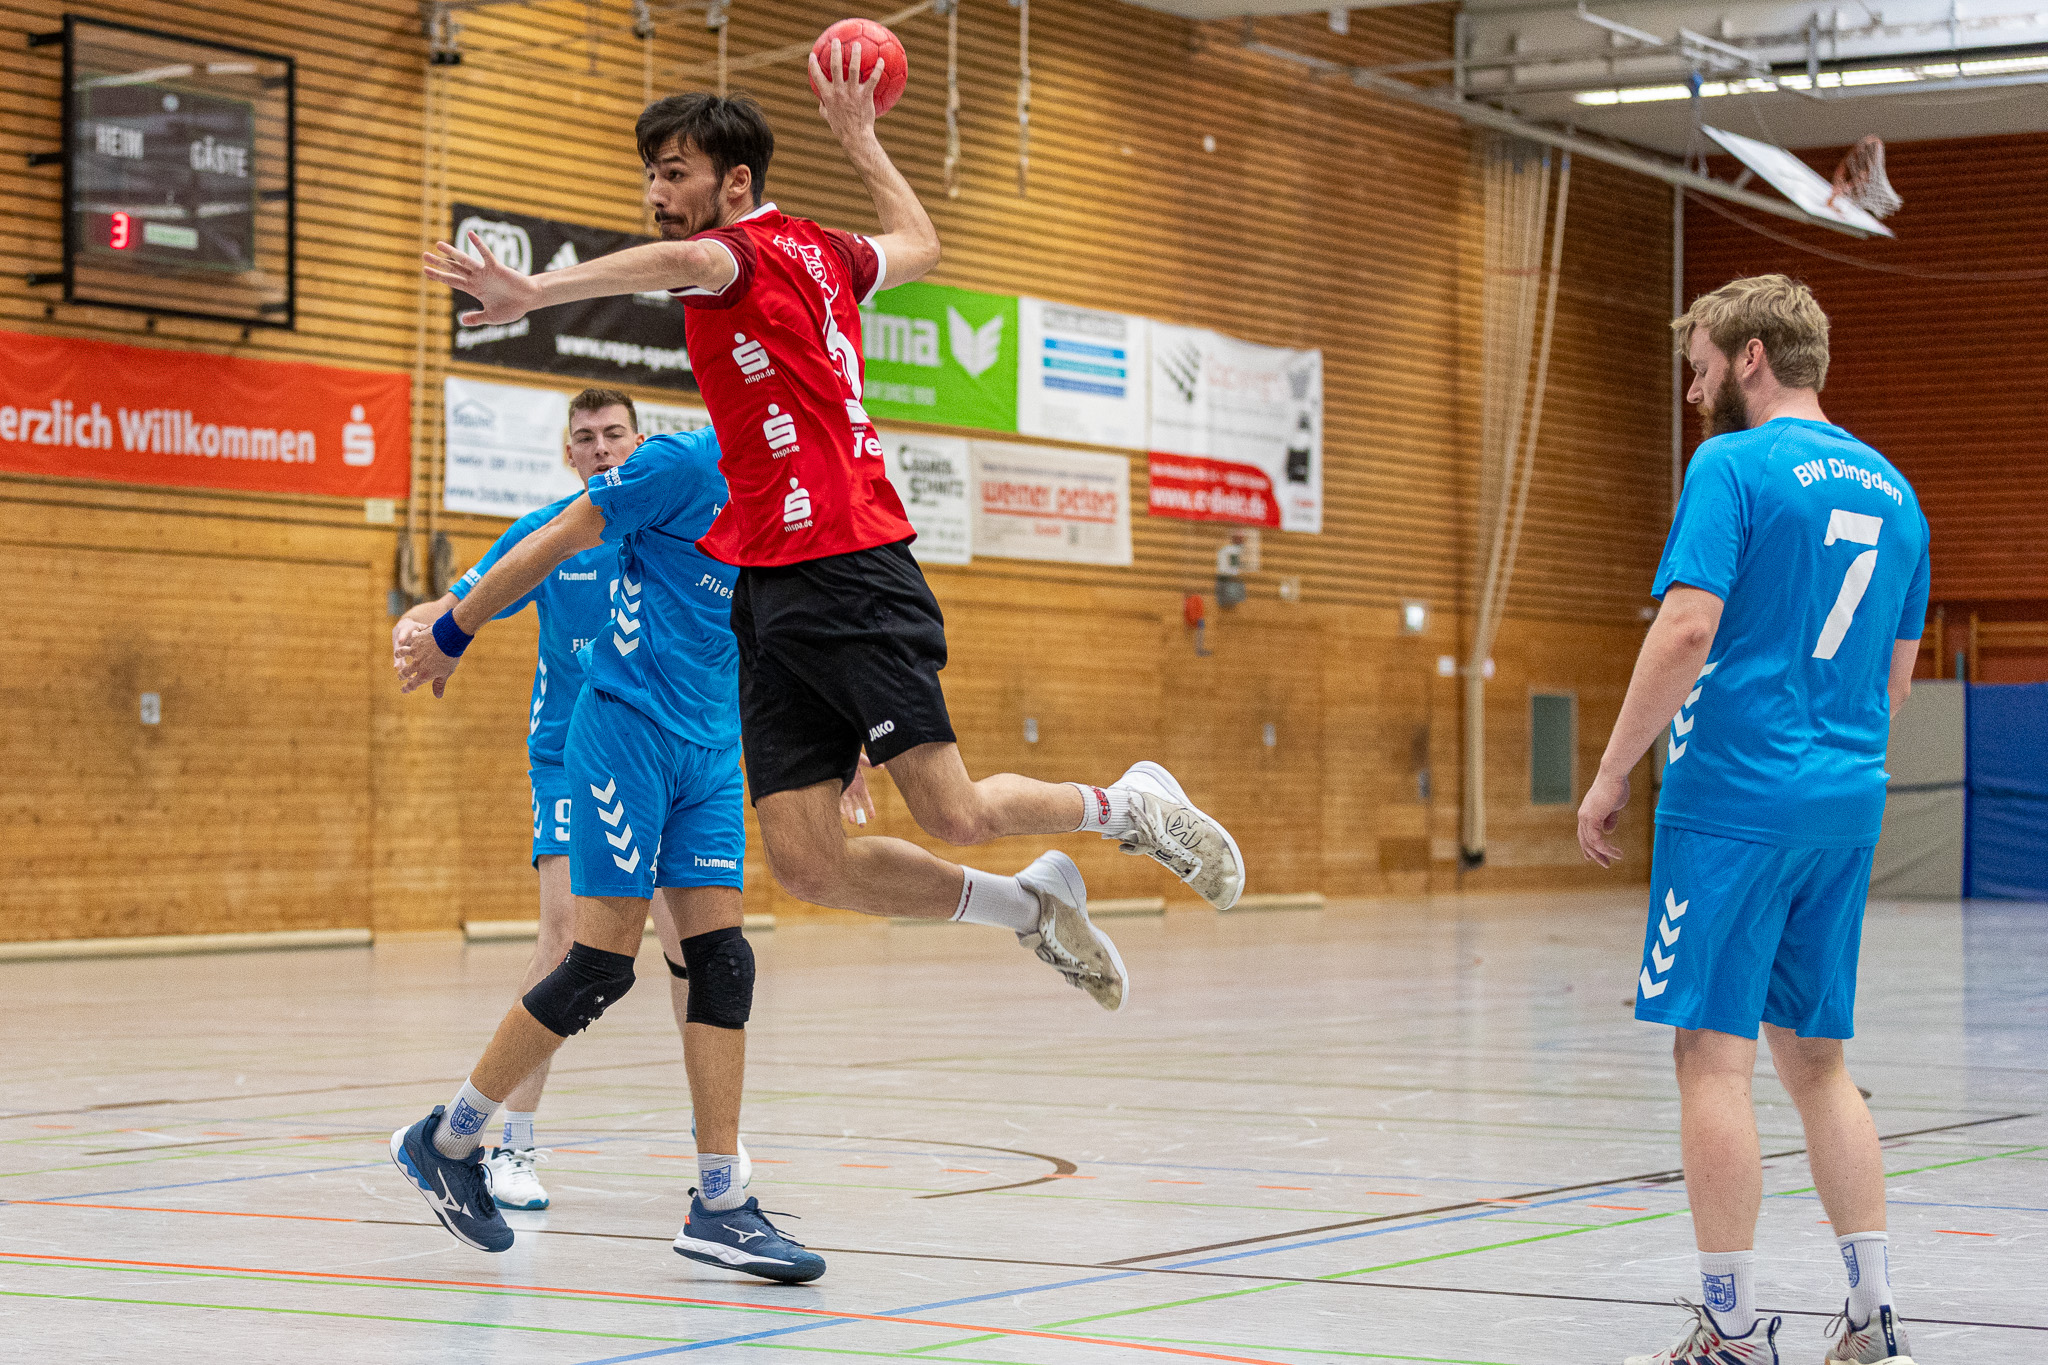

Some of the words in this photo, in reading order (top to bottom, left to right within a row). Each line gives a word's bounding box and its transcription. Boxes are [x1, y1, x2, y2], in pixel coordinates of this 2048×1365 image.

[96, 124, 144, 160] HEIM
[190, 135, 248, 178] GÄSTE
[110, 211, 131, 249] 3
[744, 367, 776, 385] nispa.de
[117, 407, 317, 464] Willkommen
[1792, 458, 1828, 488] BW
[1827, 457, 1903, 507] Dingden
[783, 519, 813, 533] nispa.de
[558, 569, 598, 581] hummel
[1811, 508, 1884, 660] 7
[869, 719, 895, 742] JAKO
[694, 855, 738, 870] hummel
